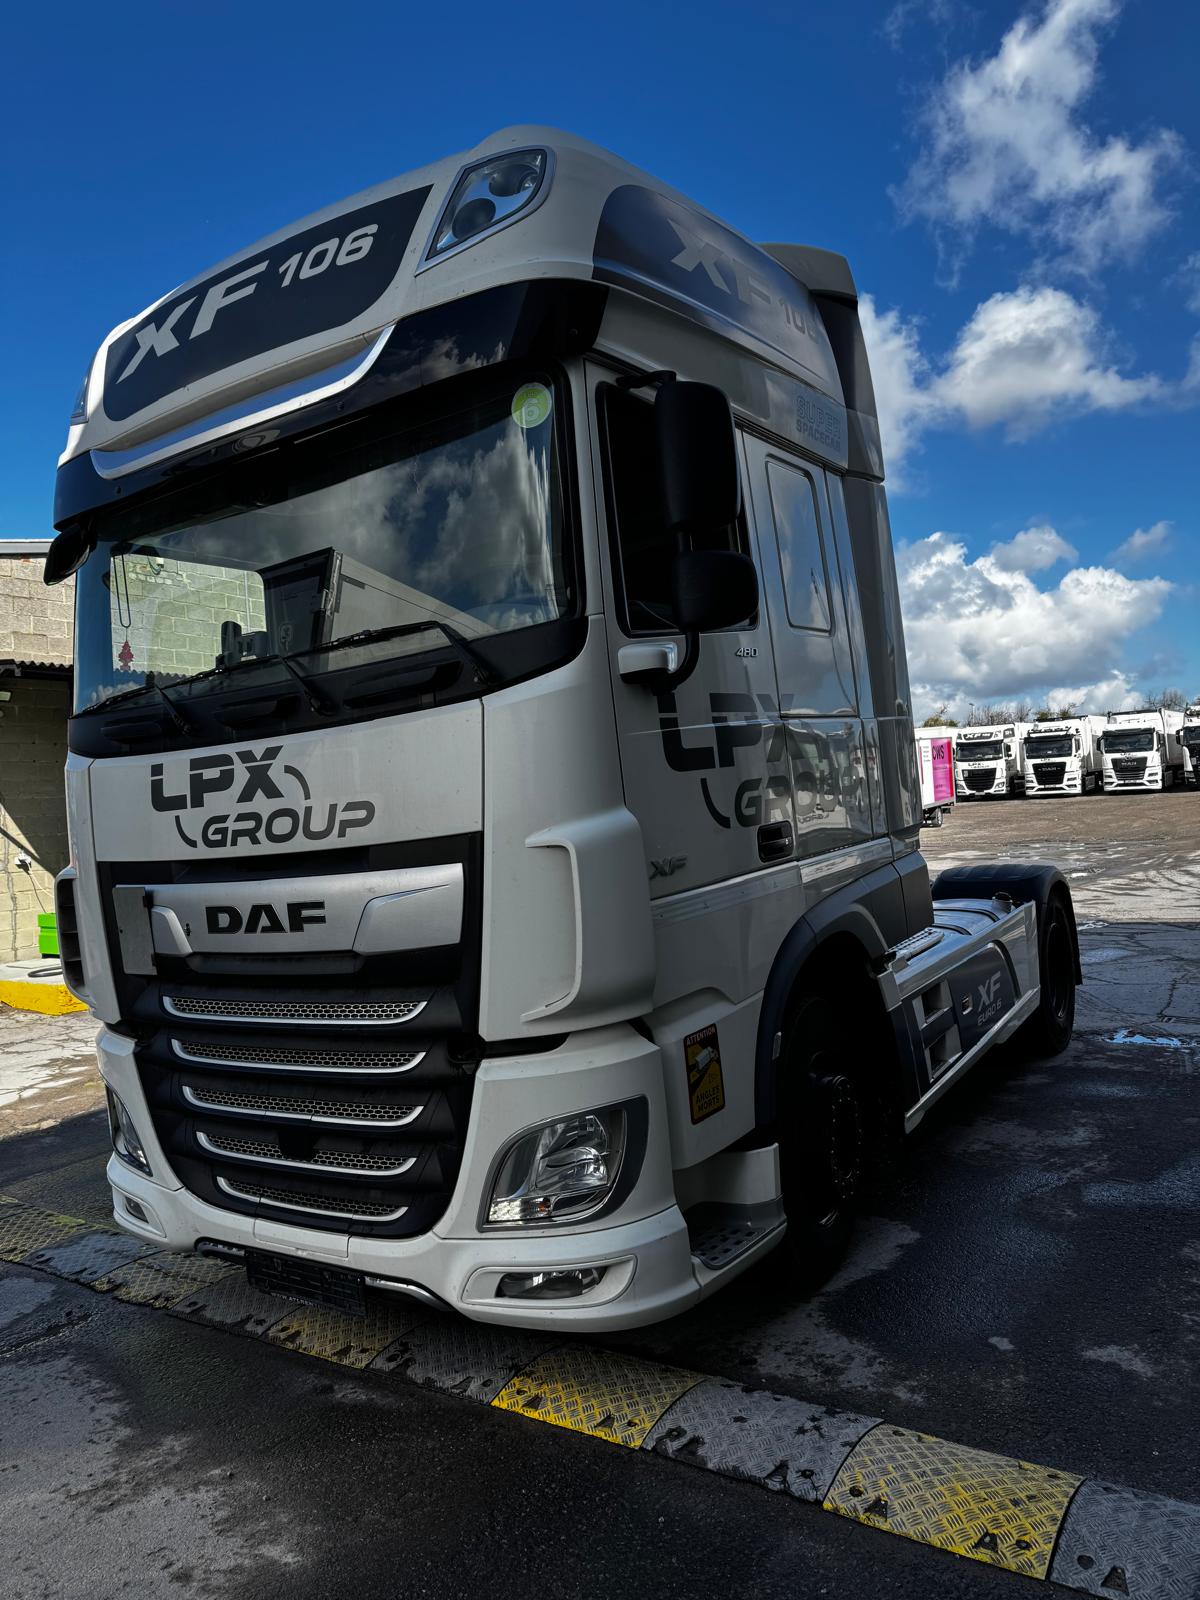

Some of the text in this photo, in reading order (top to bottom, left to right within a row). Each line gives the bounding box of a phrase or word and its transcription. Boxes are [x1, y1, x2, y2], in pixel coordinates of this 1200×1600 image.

[667, 218, 774, 305] XF
[116, 223, 379, 384] XF 106
[736, 647, 759, 658] 480
[932, 745, 945, 760] CWS
[150, 745, 285, 812] LPX
[201, 800, 376, 849] GROUP
[649, 856, 687, 880] XF
[205, 901, 326, 934] DAF
[978, 971, 1001, 1012] XF
[686, 1026, 716, 1046] ATTENTION
